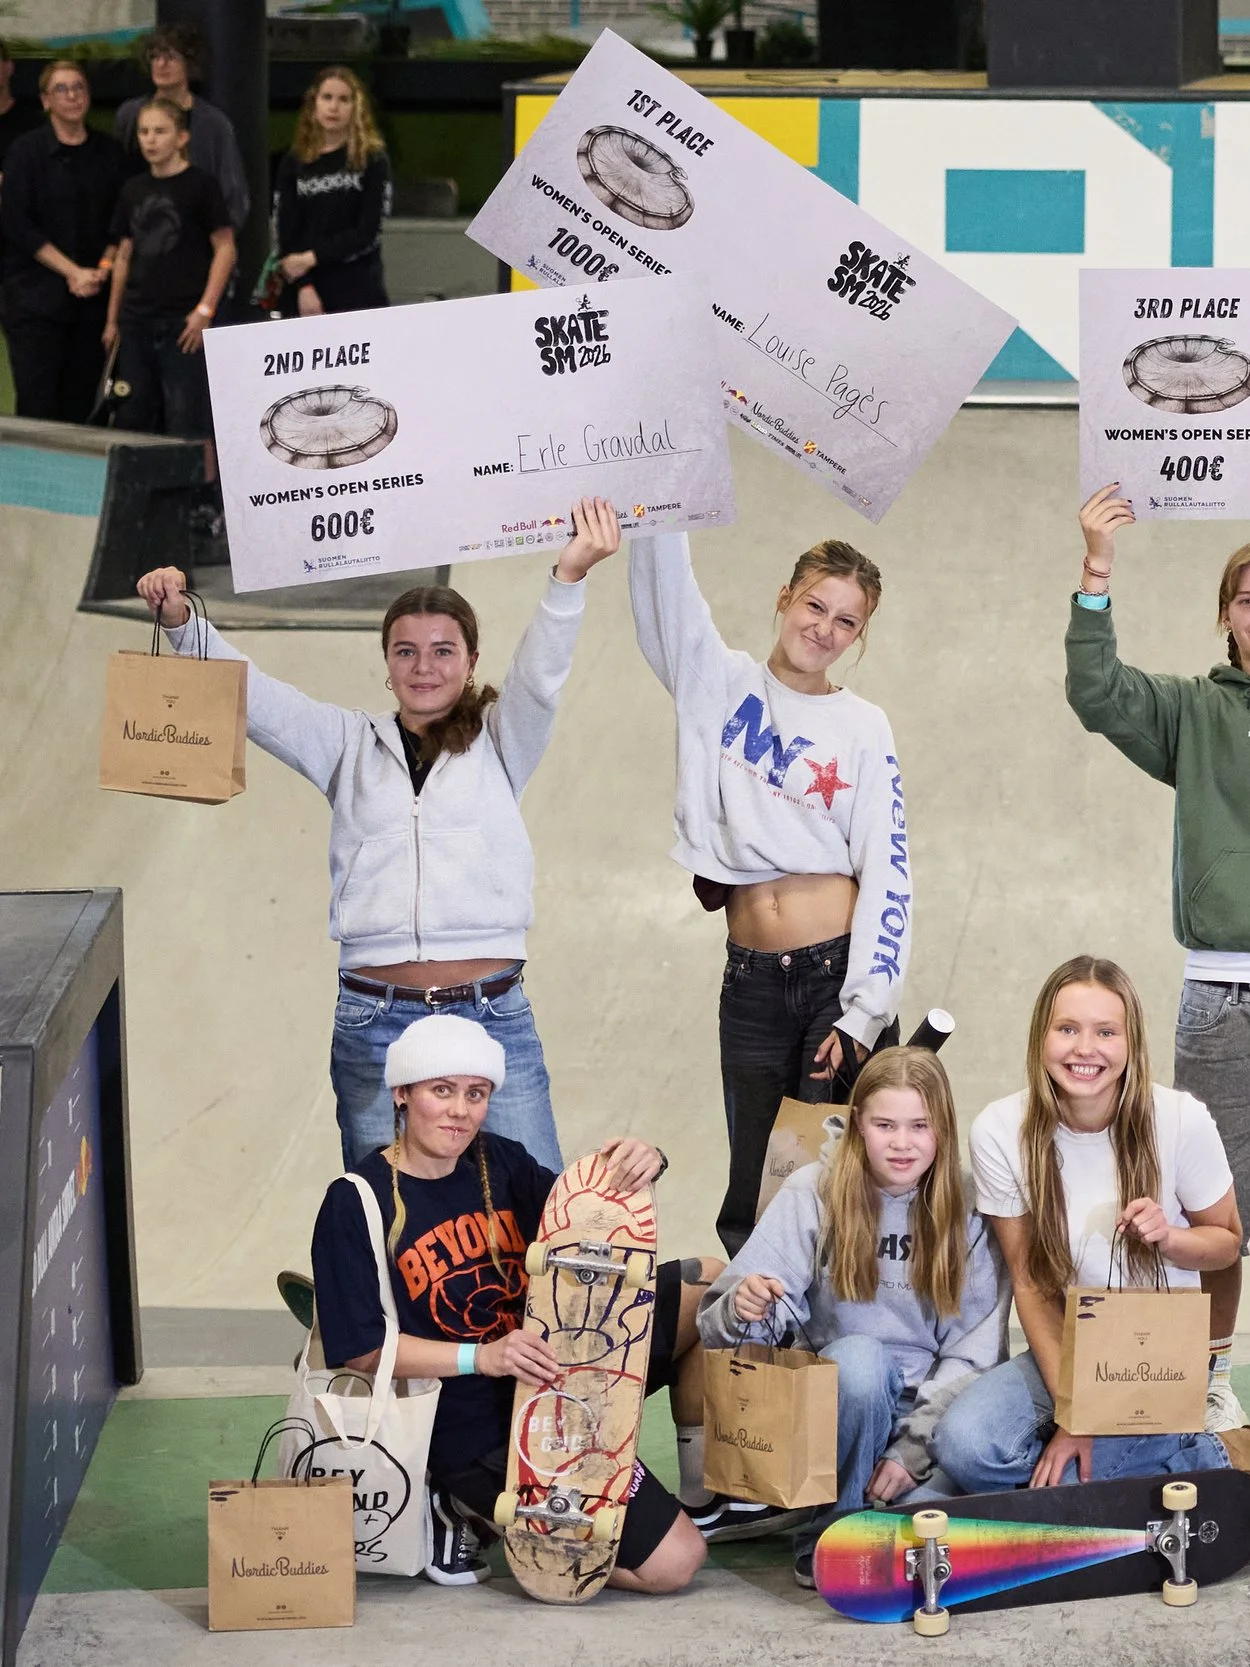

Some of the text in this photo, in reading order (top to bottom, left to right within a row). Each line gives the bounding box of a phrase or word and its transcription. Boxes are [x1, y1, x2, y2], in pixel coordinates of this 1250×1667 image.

[626, 89, 714, 157] 1ST PLACE
[531, 174, 592, 223] WOMEN'S
[592, 220, 629, 250] OPEN
[548, 227, 620, 282] 1000€
[841, 241, 916, 304] SKATE
[828, 266, 892, 321] SM 2026
[1133, 297, 1241, 319] 3RD PLACE
[535, 309, 610, 348] SKATE
[711, 303, 746, 334] NAME:
[264, 342, 371, 377] 2ND PLACE
[541, 345, 611, 376] SM 2026
[748, 313, 815, 381] Louise
[518, 420, 677, 474] Erle Gravdal
[1105, 428, 1179, 441] WOMEN'S
[1181, 428, 1224, 441] OPEN
[473, 462, 514, 478] NAME:
[816, 450, 847, 475] TAMPERE
[1160, 455, 1225, 482] 400€
[249, 472, 424, 508] WOMEN'S OPEN SERIES
[647, 502, 682, 513] TAMPERE
[310, 508, 375, 542] 600€
[502, 520, 537, 534] Red Bull
[318, 554, 347, 563] SUOMEN
[721, 692, 816, 789] NY
[397, 1210, 527, 1301] BEYOND
[352, 1491, 389, 1509] ND
